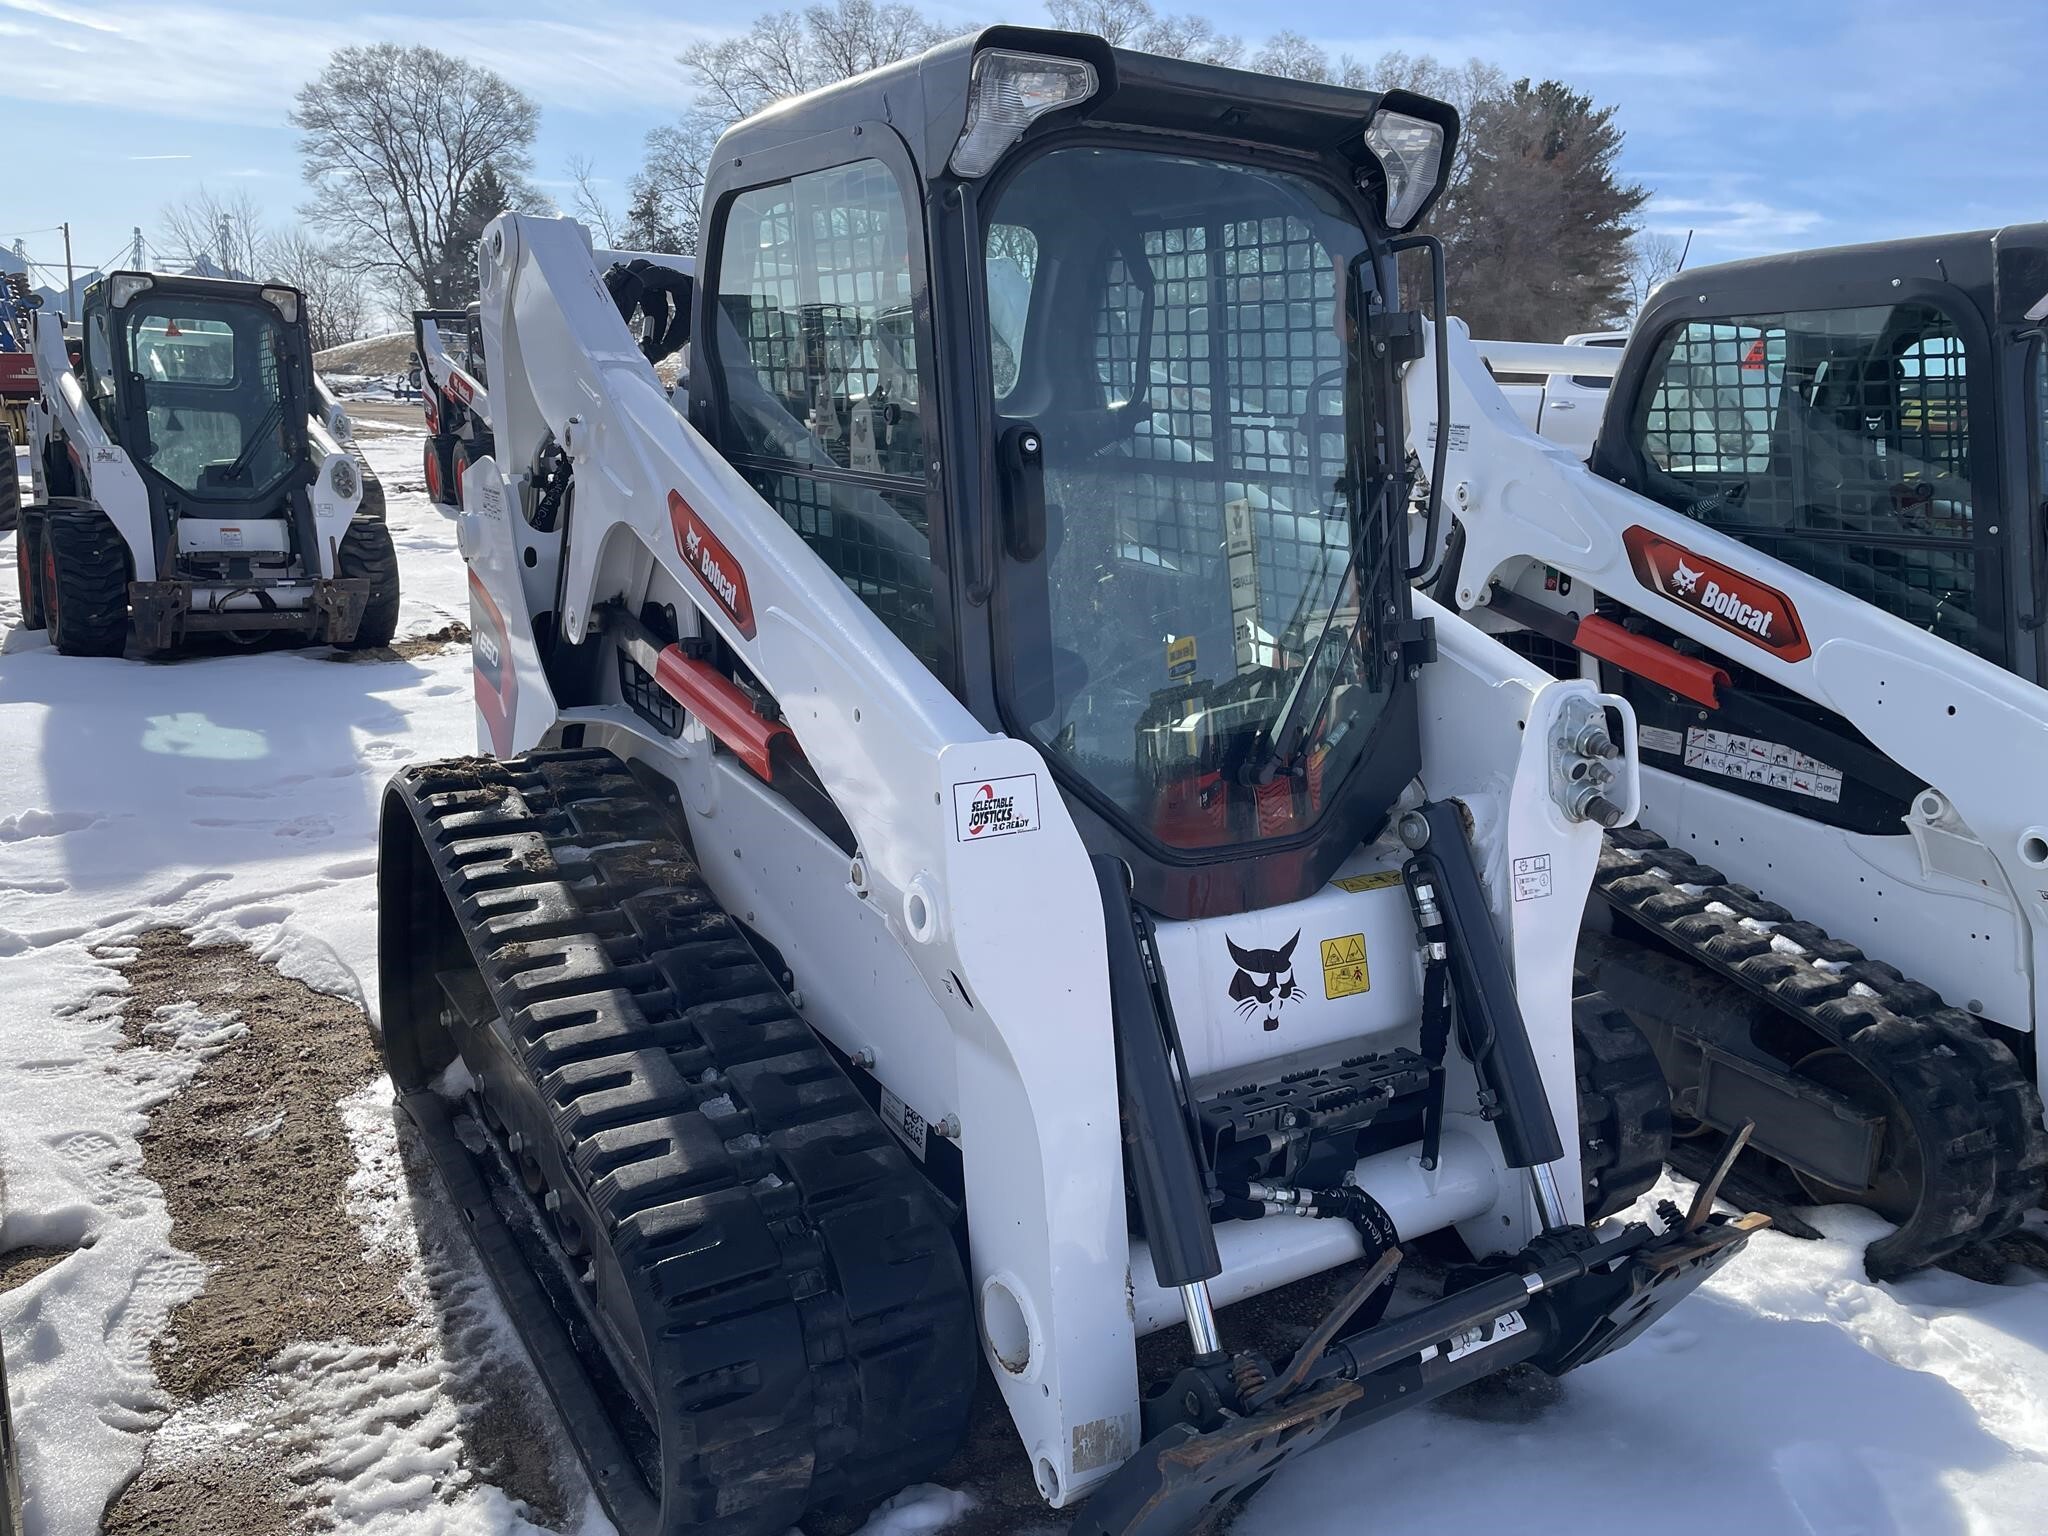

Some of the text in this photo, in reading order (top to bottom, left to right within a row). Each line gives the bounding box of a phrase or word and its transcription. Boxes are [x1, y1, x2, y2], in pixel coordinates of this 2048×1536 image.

[701, 547, 737, 611] Bobcat
[1700, 581, 1773, 636] Bobcat
[969, 807, 1012, 827] JOYSTICKS
[971, 796, 1013, 812] SELECTABLE
